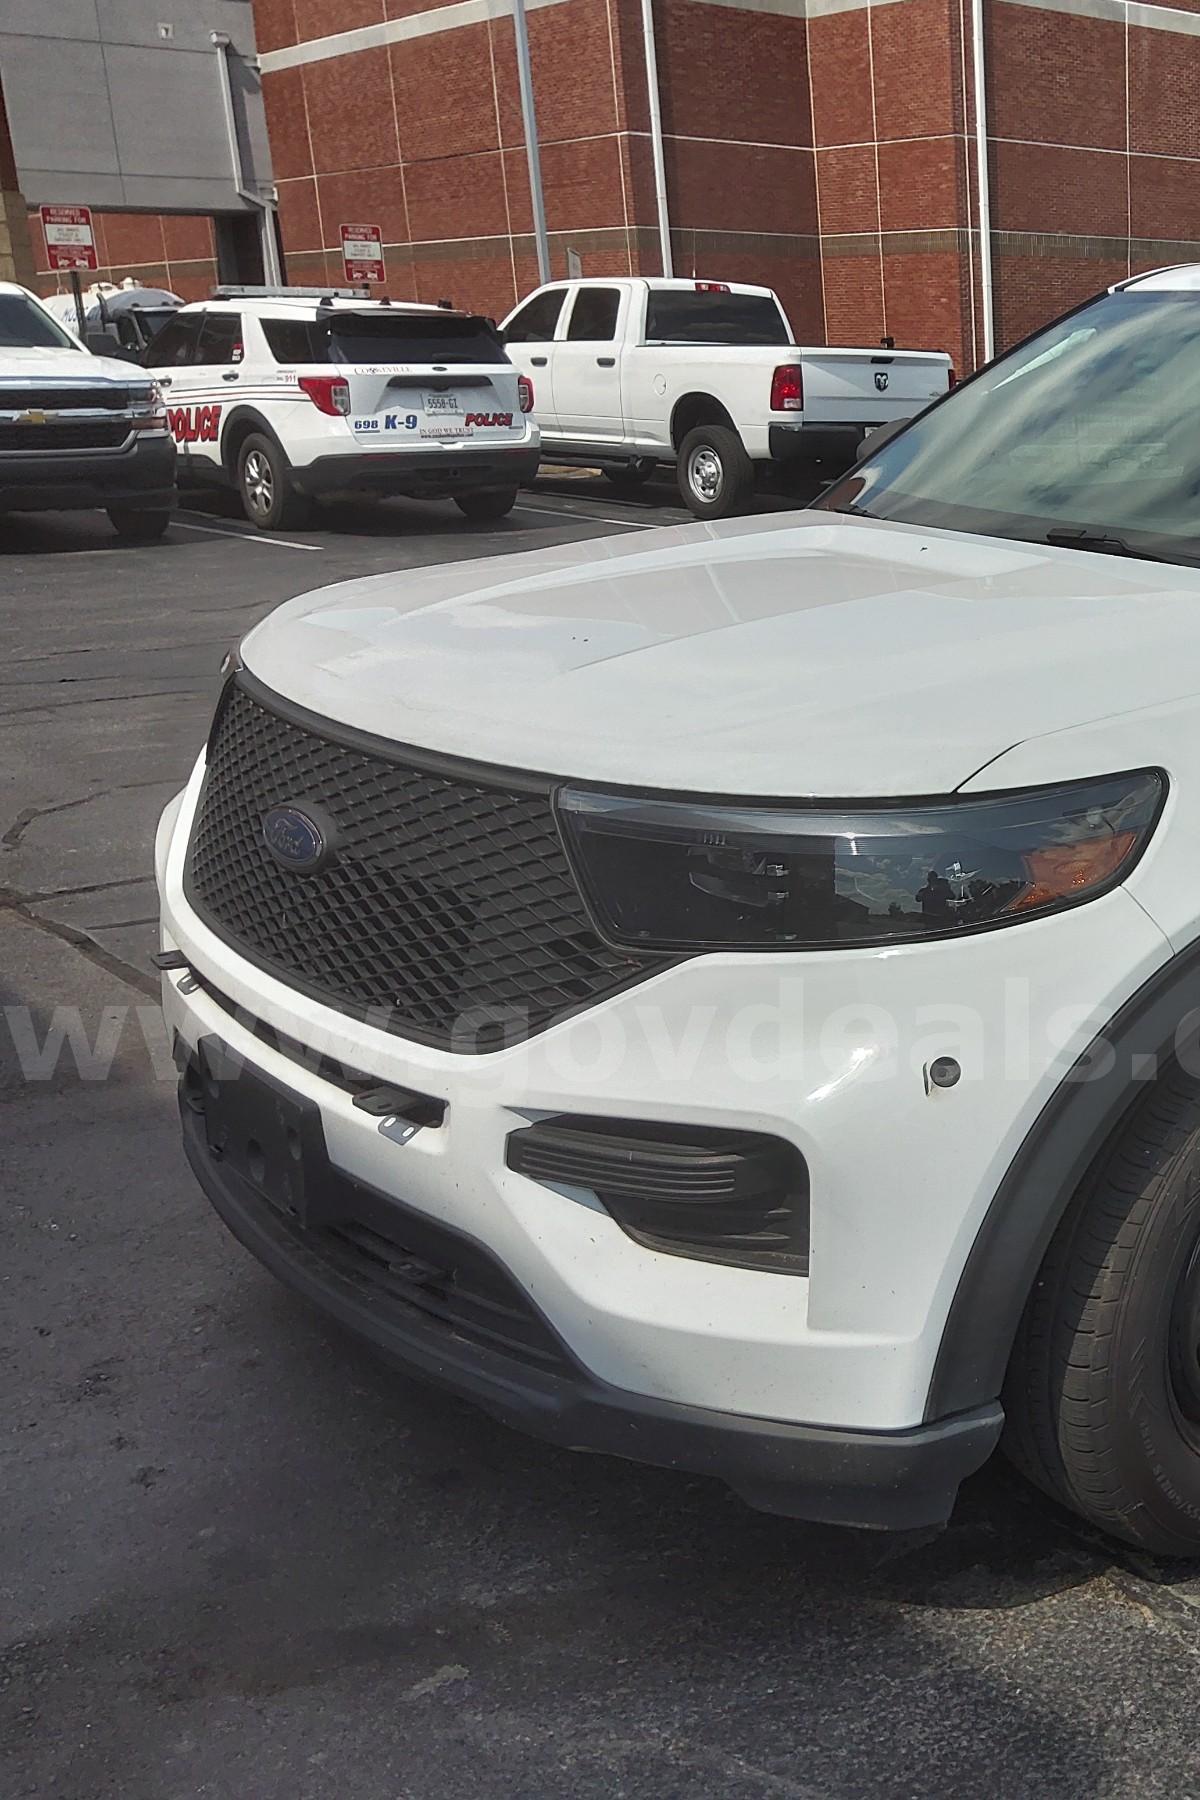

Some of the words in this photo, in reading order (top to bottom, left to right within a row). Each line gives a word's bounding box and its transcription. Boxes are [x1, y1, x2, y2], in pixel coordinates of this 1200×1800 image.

[354, 420, 379, 430] 698
[384, 414, 418, 430] K-9
[464, 412, 513, 427] POLICE
